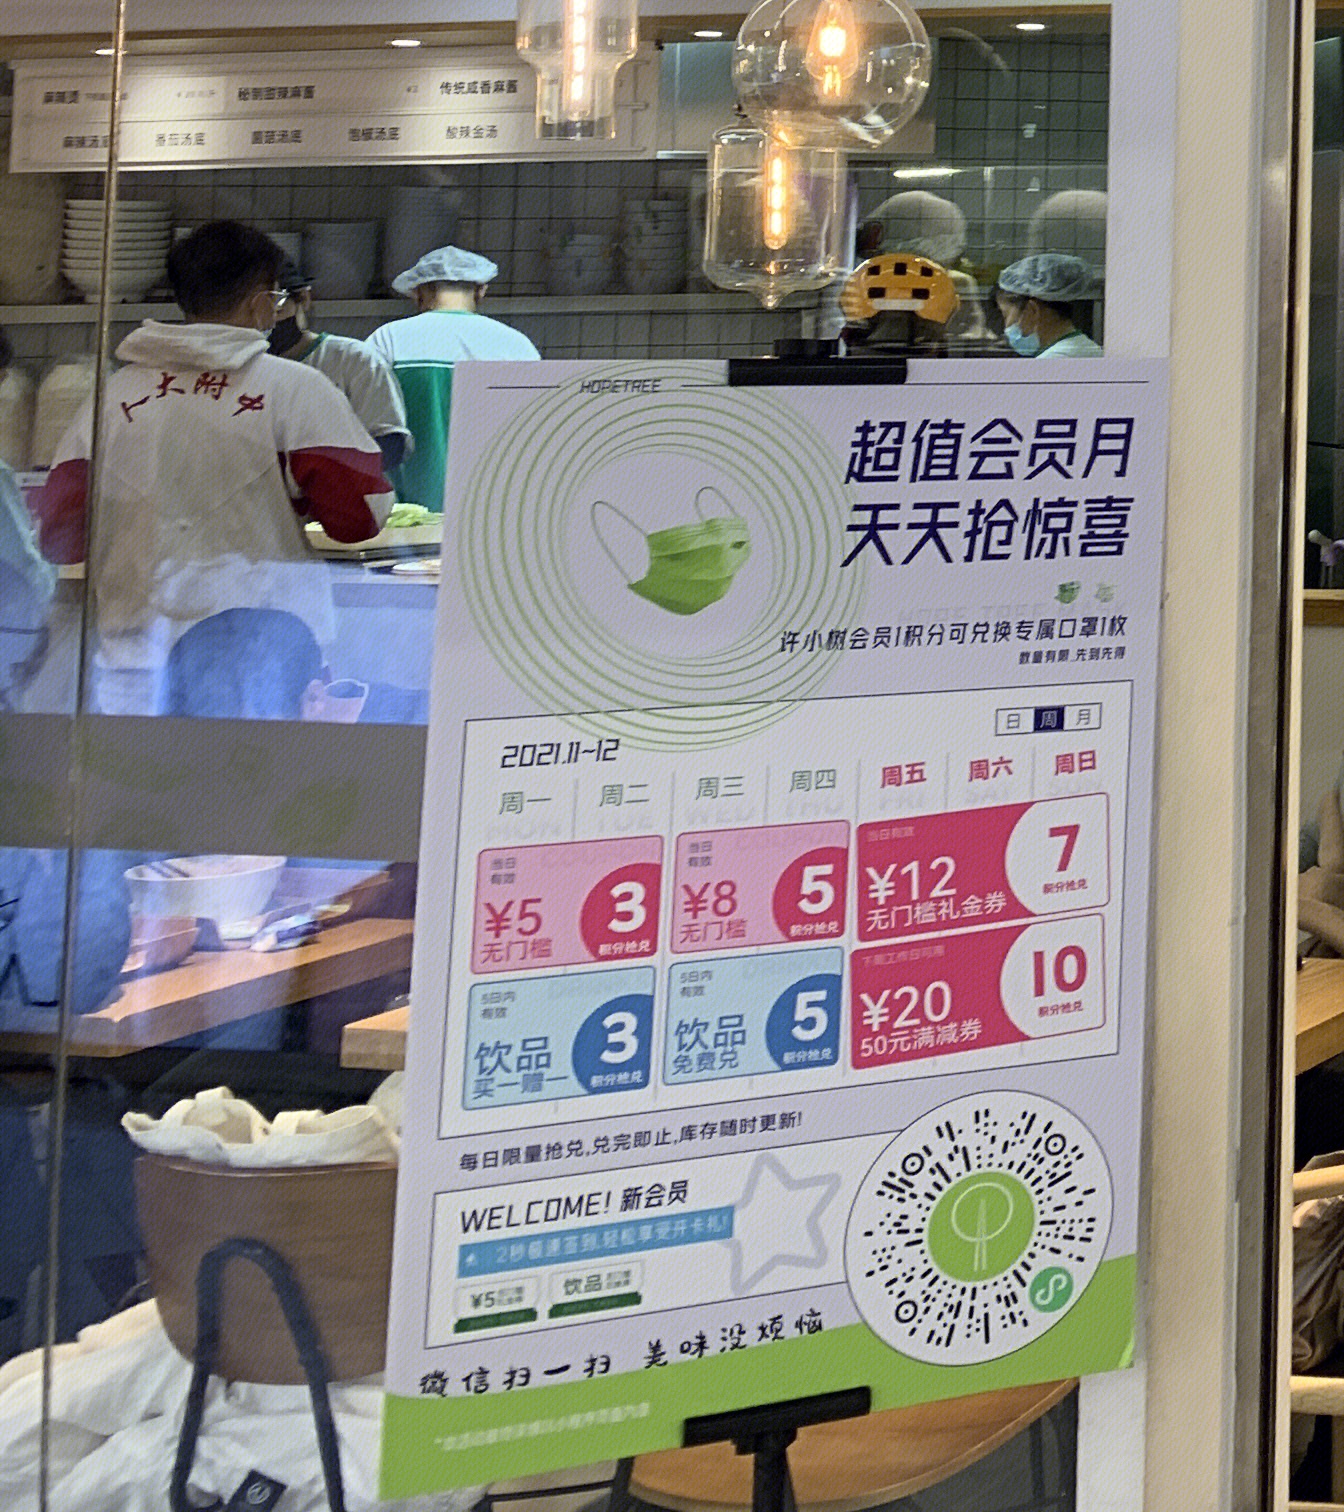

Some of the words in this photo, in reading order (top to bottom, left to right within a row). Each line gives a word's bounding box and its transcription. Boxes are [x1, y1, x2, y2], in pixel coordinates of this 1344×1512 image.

[843, 416, 1135, 486] 超值会员月
[840, 494, 1135, 568] 天天抢惊喜
[1006, 714, 1020, 730] 日
[1040, 710, 1058, 728] 周
[1076, 708, 1091, 726] 月
[499, 790, 552, 815] 周一
[599, 783, 650, 808] 周二
[695, 775, 745, 801] 周三
[789, 768, 837, 793] 周四
[881, 762, 927, 788] 周五
[968, 756, 1013, 783] 周六
[1054, 749, 1096, 776] 周日
[1048, 824, 1081, 873] 7
[606, 880, 647, 934] 3
[797, 864, 835, 915] 5
[867, 890, 1007, 932] 无门槛礼金券
[481, 938, 553, 964] 无门槛
[680, 917, 747, 944] 无门槛
[1032, 944, 1088, 998] 10
[600, 1010, 639, 1064] 3
[674, 1013, 747, 1052] 饮品
[791, 990, 829, 1042] 5
[860, 1017, 983, 1059] 50元满减券
[474, 1036, 552, 1076] 饮品
[672, 1048, 740, 1076] 免费兑
[472, 1072, 568, 1100] 买一赠一
[460, 1190, 612, 1235] WELCOME!
[620, 1179, 689, 1213] 新会员
[419, 1353, 611, 1397] 微信扫一扫
